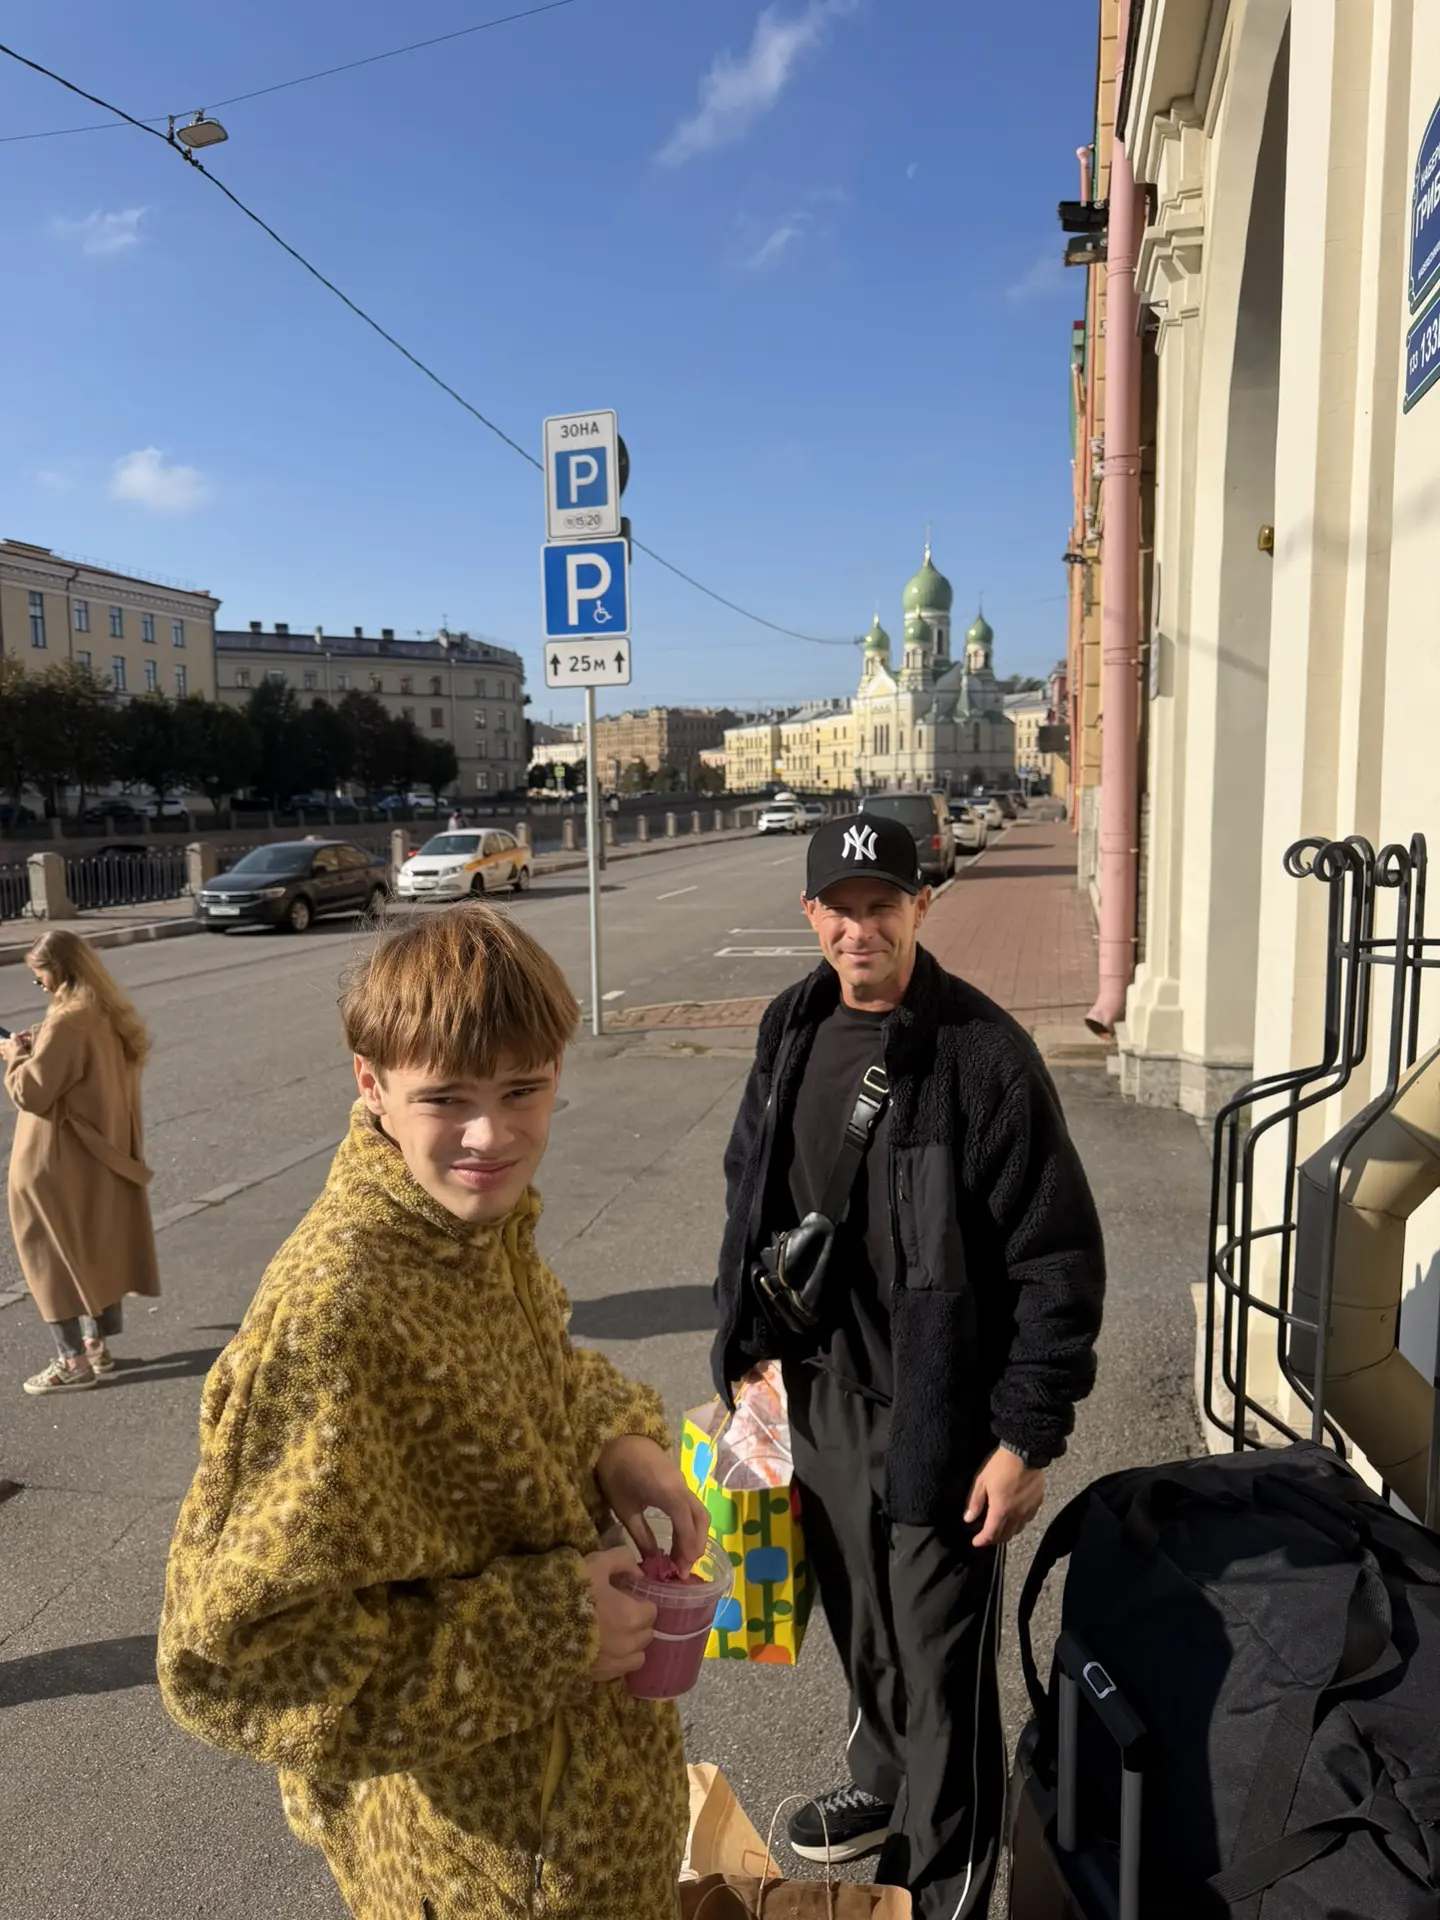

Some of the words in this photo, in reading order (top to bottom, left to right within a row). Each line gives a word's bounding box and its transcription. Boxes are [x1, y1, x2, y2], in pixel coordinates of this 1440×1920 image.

[560, 421, 600, 438] ЗОНА
[569, 454, 599, 503] P
[566, 553, 612, 626] P
[841, 824, 879, 861] NY
